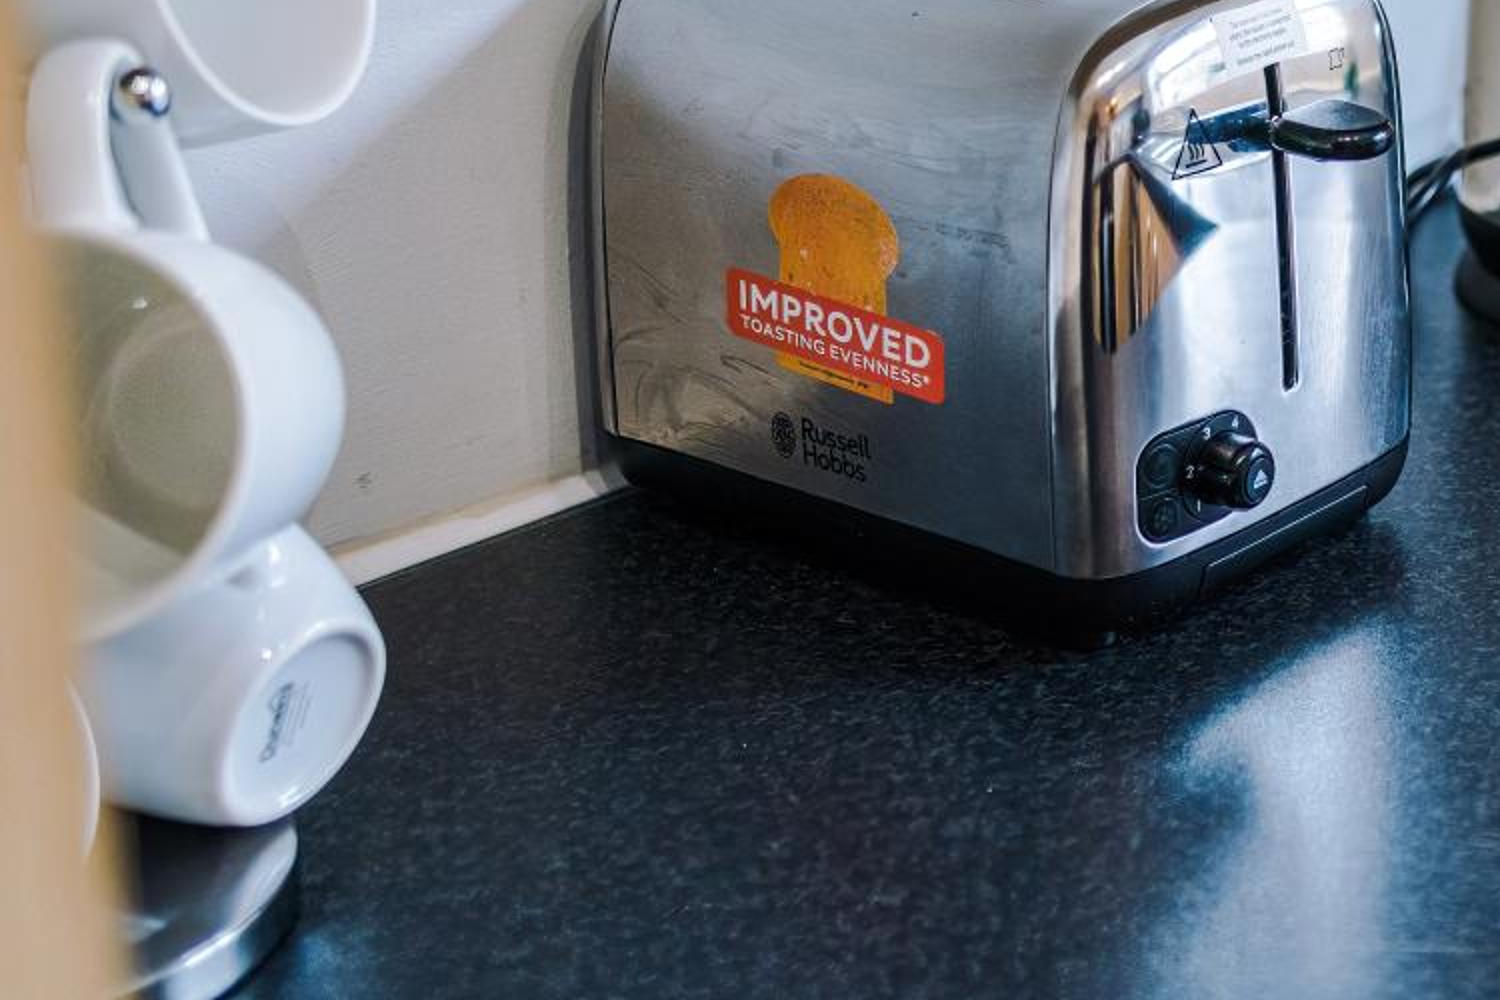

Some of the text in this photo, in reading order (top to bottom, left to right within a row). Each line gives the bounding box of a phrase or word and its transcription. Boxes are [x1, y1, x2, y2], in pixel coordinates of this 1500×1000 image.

[738, 279, 930, 369] IMPROVED
[739, 313, 825, 355] TOASTING
[801, 417, 871, 459] Russell
[1202, 427, 1211, 440] 3
[1231, 415, 1239, 429] 4
[803, 442, 866, 482] Hobbs
[1185, 465, 1195, 479] 2
